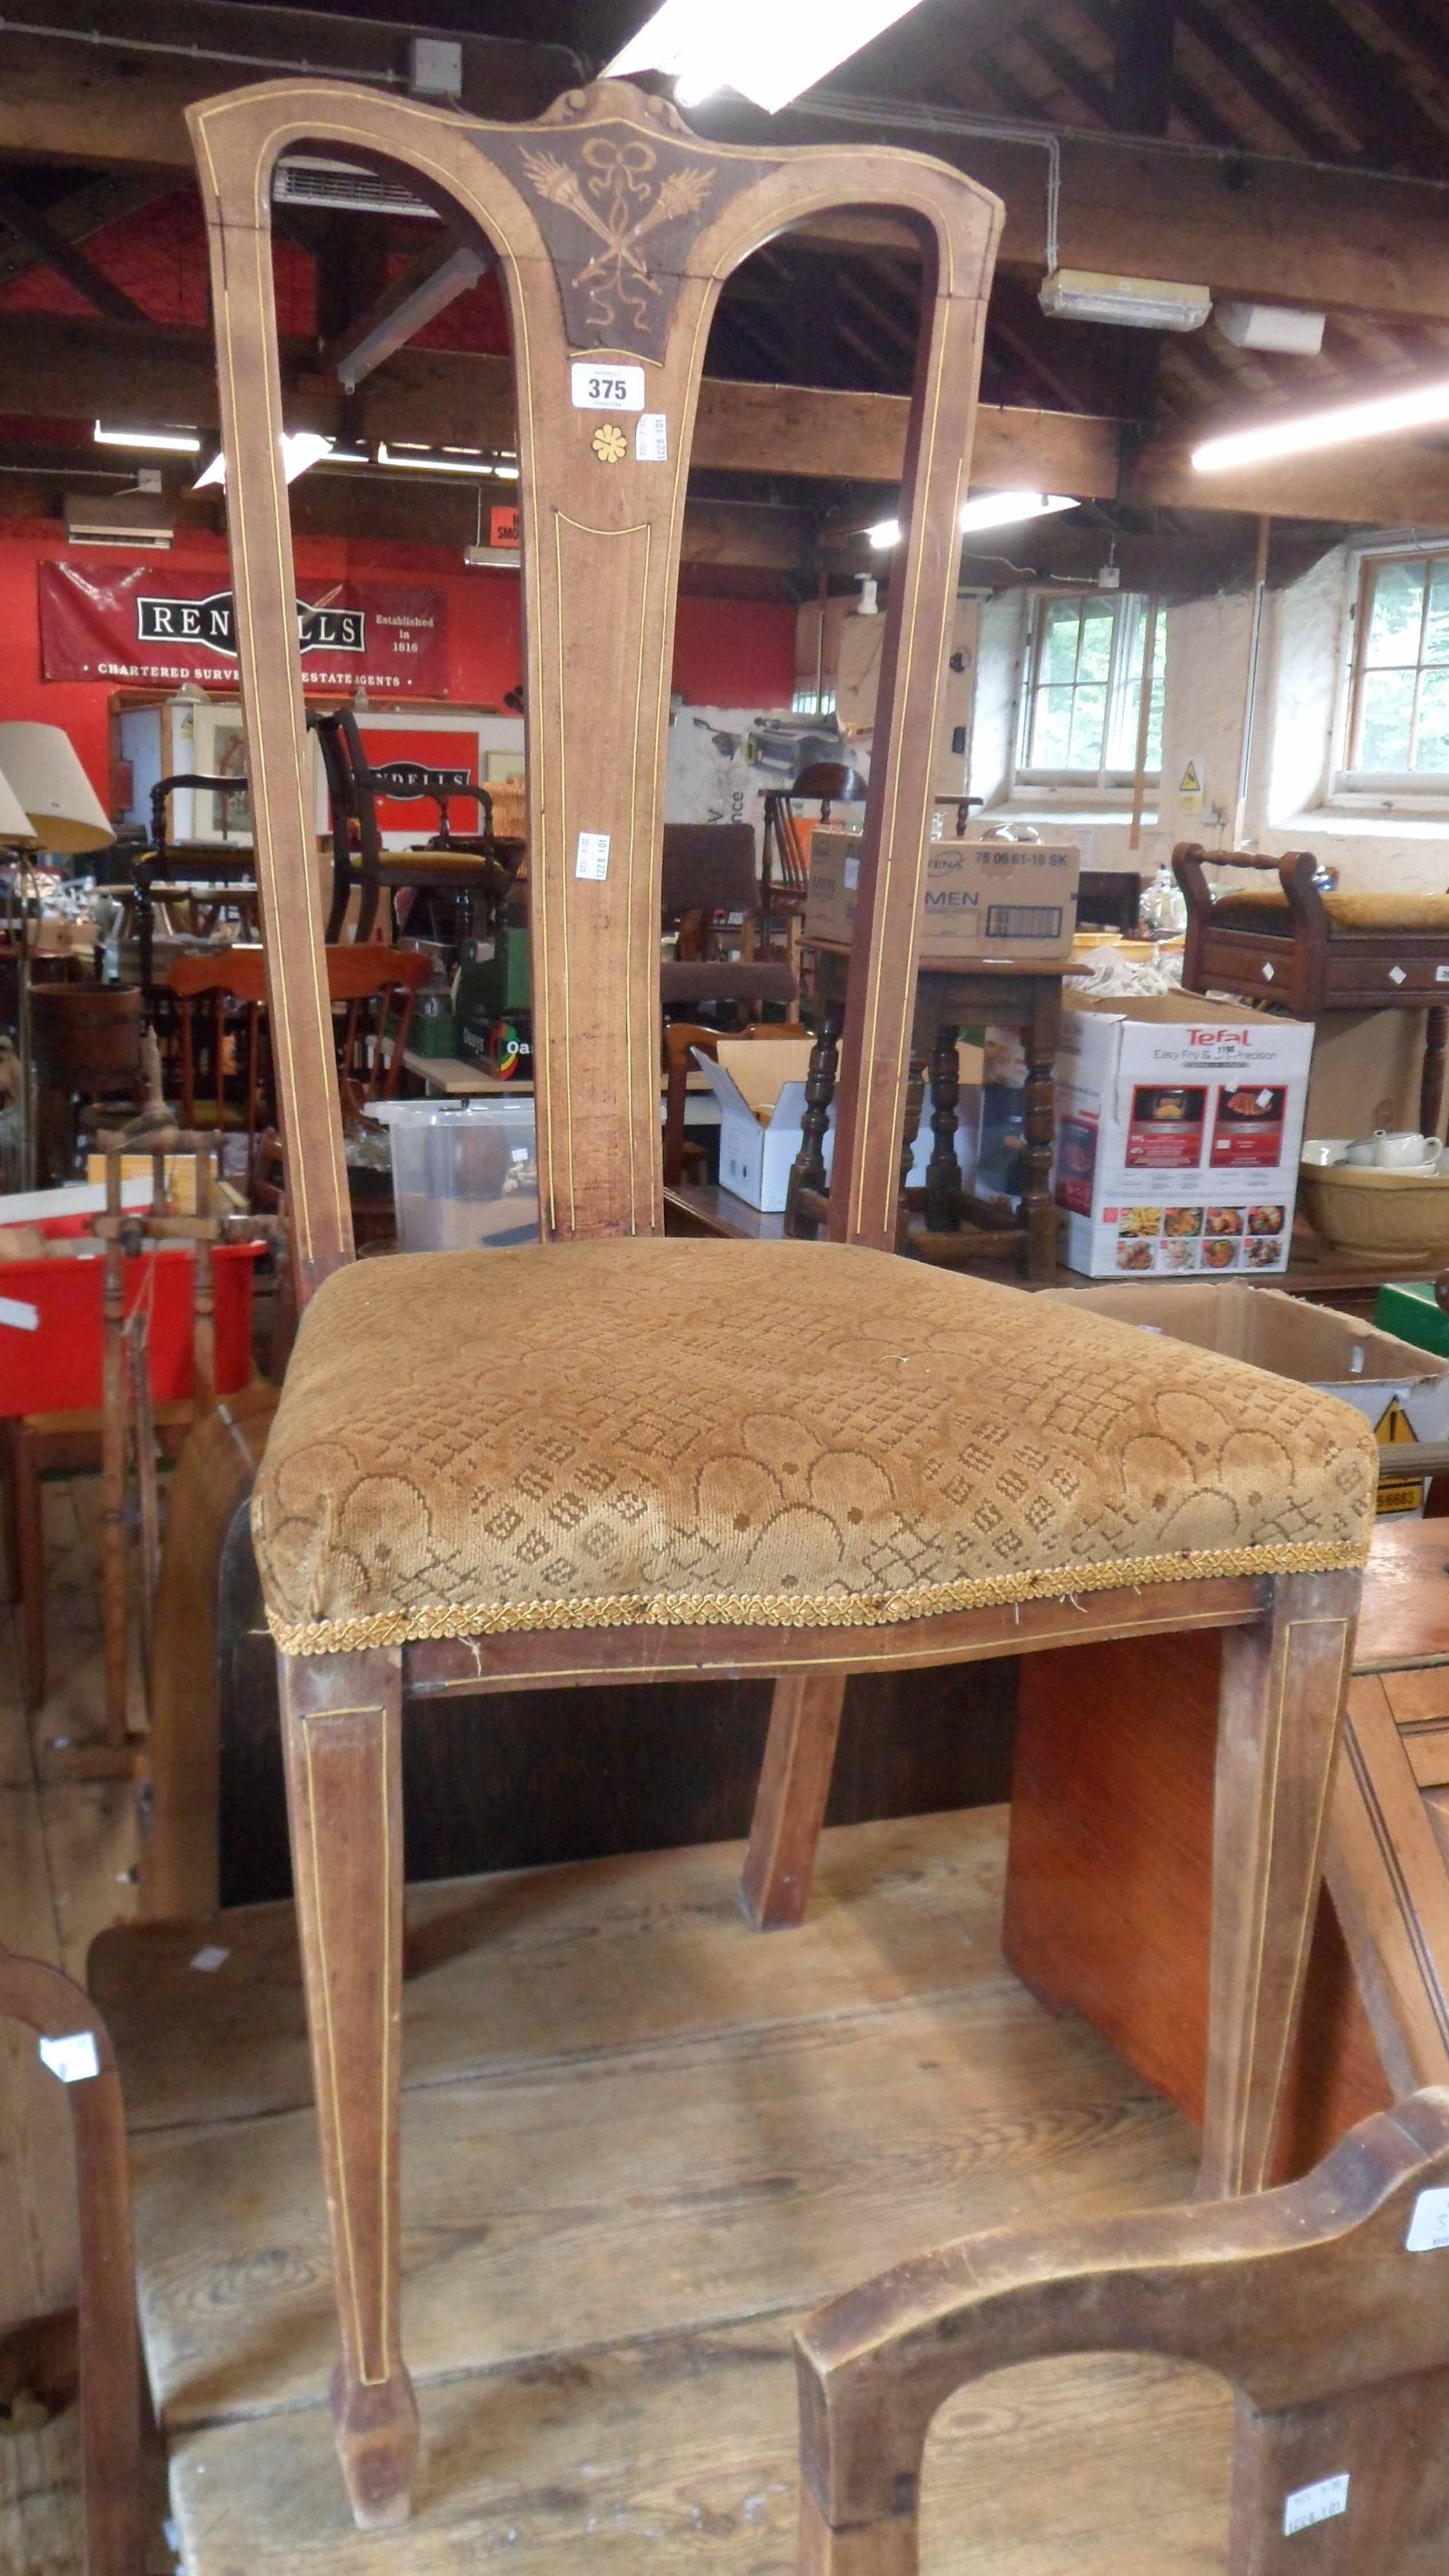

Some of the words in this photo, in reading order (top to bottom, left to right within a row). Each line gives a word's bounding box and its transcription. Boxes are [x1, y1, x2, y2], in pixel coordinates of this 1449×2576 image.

[588, 378, 627, 400] 375
[376, 614, 433, 627] Established
[399, 630, 410, 639] in
[98, 663, 189, 678] CHARTERED
[195, 669, 239, 681] SURVE
[302, 673, 352, 683] ESTATE
[354, 674, 400, 686] AGENTS
[1049, 853, 1067, 866] SK
[596, 858, 606, 878] 1228
[925, 891, 979, 906] MEN
[1187, 1030, 1252, 1046] Tefal
[1154, 1050, 1178, 1060] Easy
[1181, 1050, 1199, 1060] Fry
[1202, 1050, 1211, 1059] &
